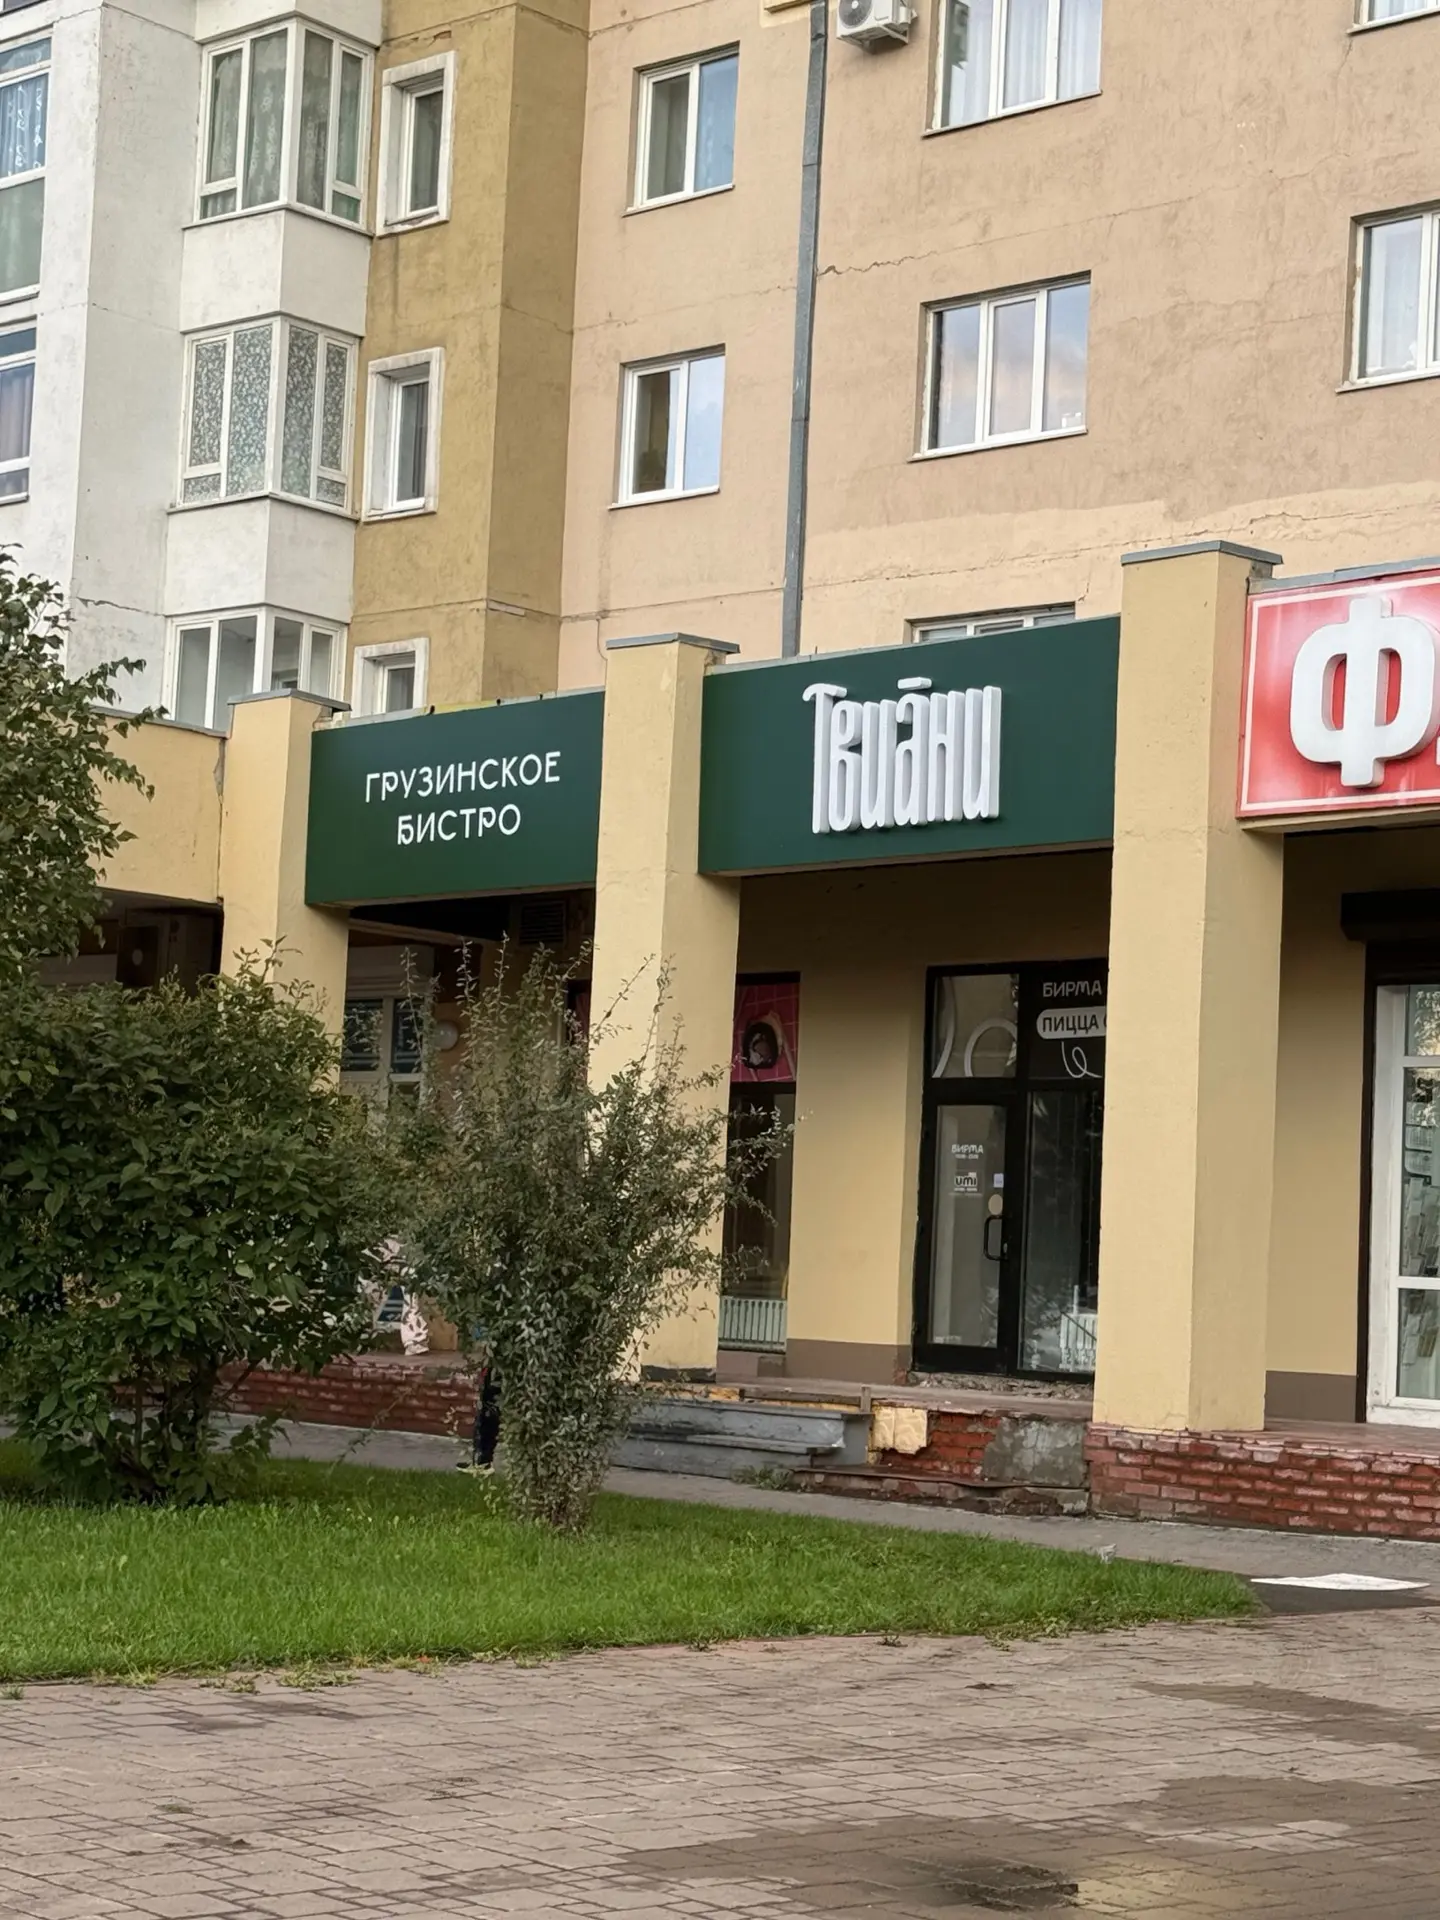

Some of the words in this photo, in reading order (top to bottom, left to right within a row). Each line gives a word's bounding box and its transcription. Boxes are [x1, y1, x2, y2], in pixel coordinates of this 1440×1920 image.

[1289, 597, 1440, 788] Ф
[365, 751, 561, 803] ГРУЗИНСКОЕ
[397, 803, 521, 845] БИСТРО
[1042, 980, 1103, 998] БИРМА
[1042, 1014, 1099, 1035] ПИЦЦА
[951, 1144, 984, 1154] БИРМА
